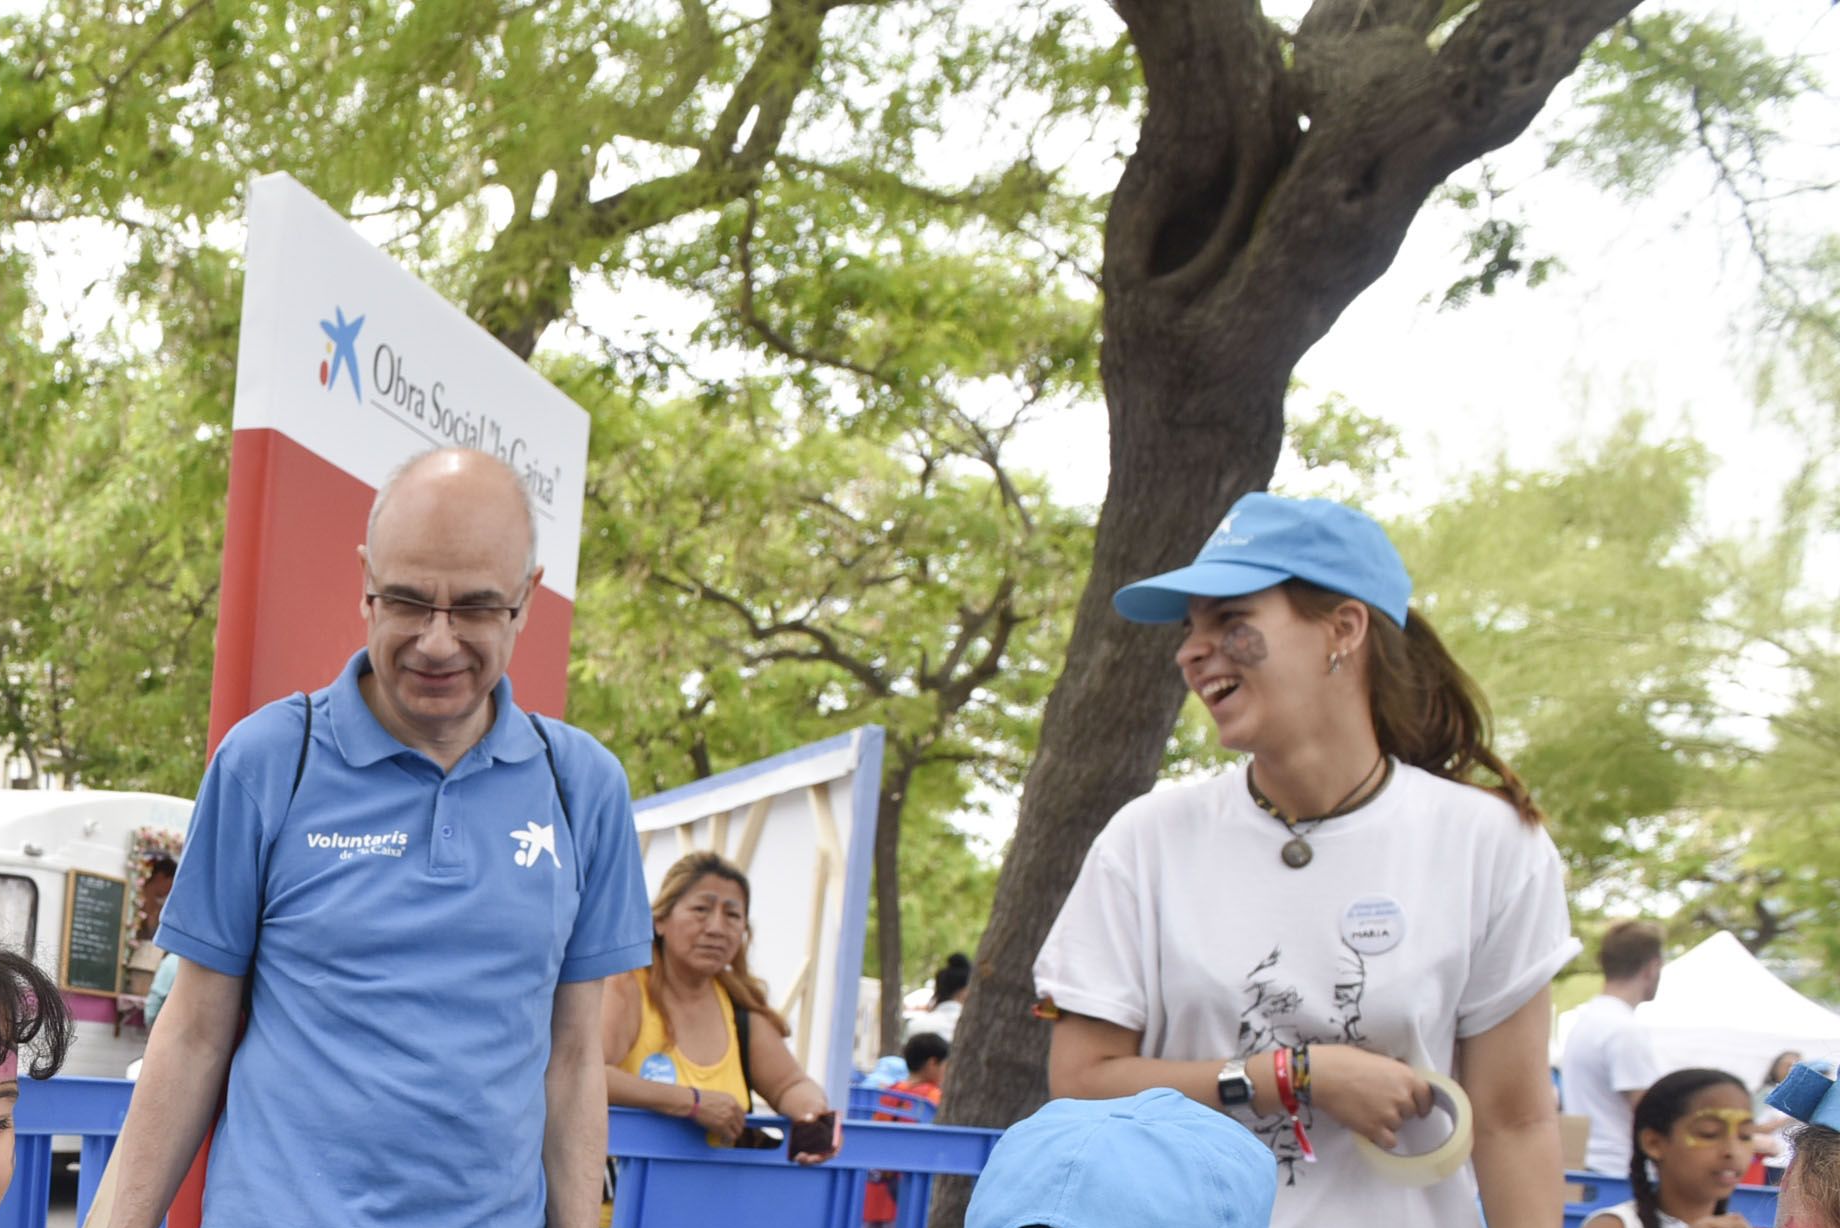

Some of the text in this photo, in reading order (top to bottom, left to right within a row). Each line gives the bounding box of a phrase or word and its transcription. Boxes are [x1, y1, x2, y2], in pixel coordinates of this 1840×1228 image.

[373, 343, 425, 418] Obra
[430, 382, 486, 452] Social
[306, 830, 409, 848] Voluntaris
